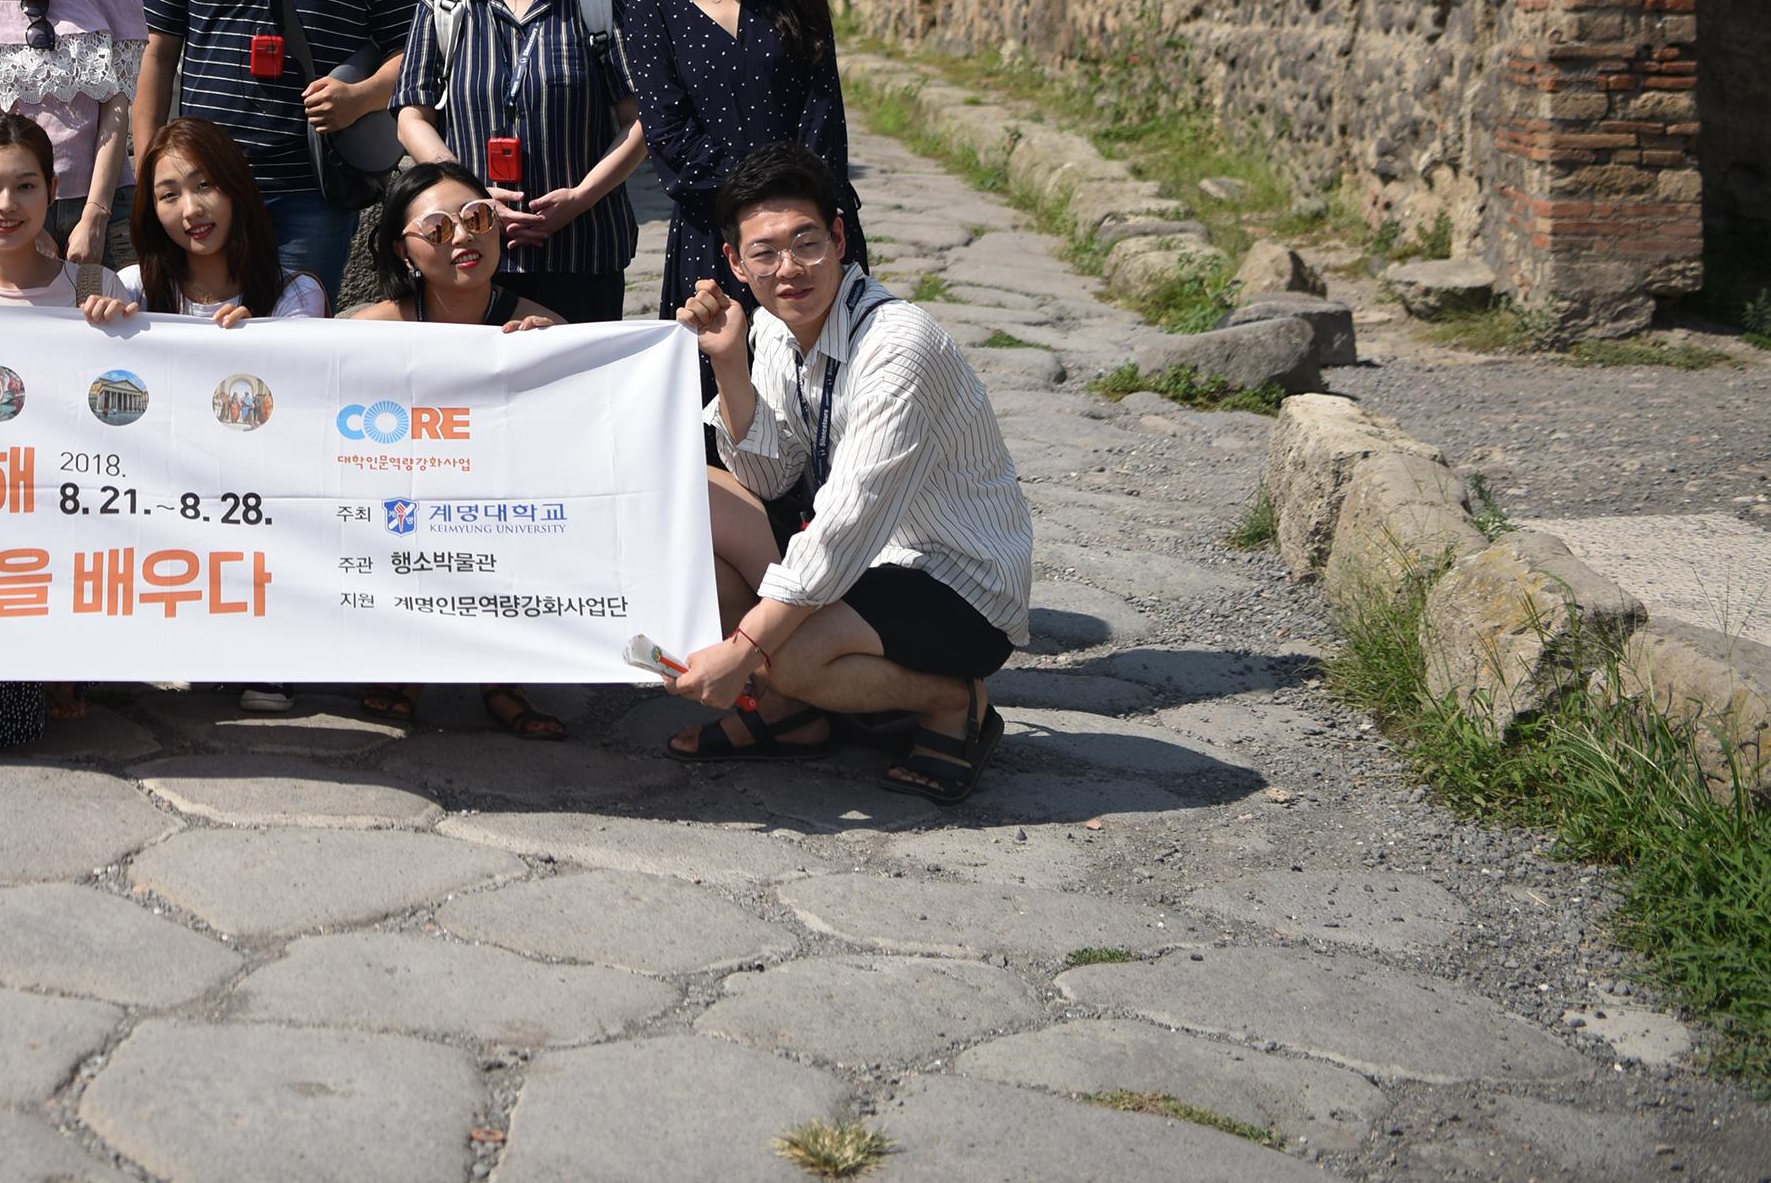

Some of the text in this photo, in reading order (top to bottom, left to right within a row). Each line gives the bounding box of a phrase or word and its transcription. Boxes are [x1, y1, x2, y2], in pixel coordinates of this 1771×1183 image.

[336, 401, 470, 444] CORE
[60, 451, 127, 478] 2018.
[337, 455, 471, 472] 대학인문역량강화사업
[336, 505, 371, 523] 주최
[428, 502, 568, 523] 계명대학교
[429, 523, 567, 535] KEIMYUNG UNIVERSITY
[338, 551, 497, 575] 주관 행소박물관
[72, 547, 273, 619] 배우다
[339, 591, 629, 618] 지원 계명인문역량강화사업단
